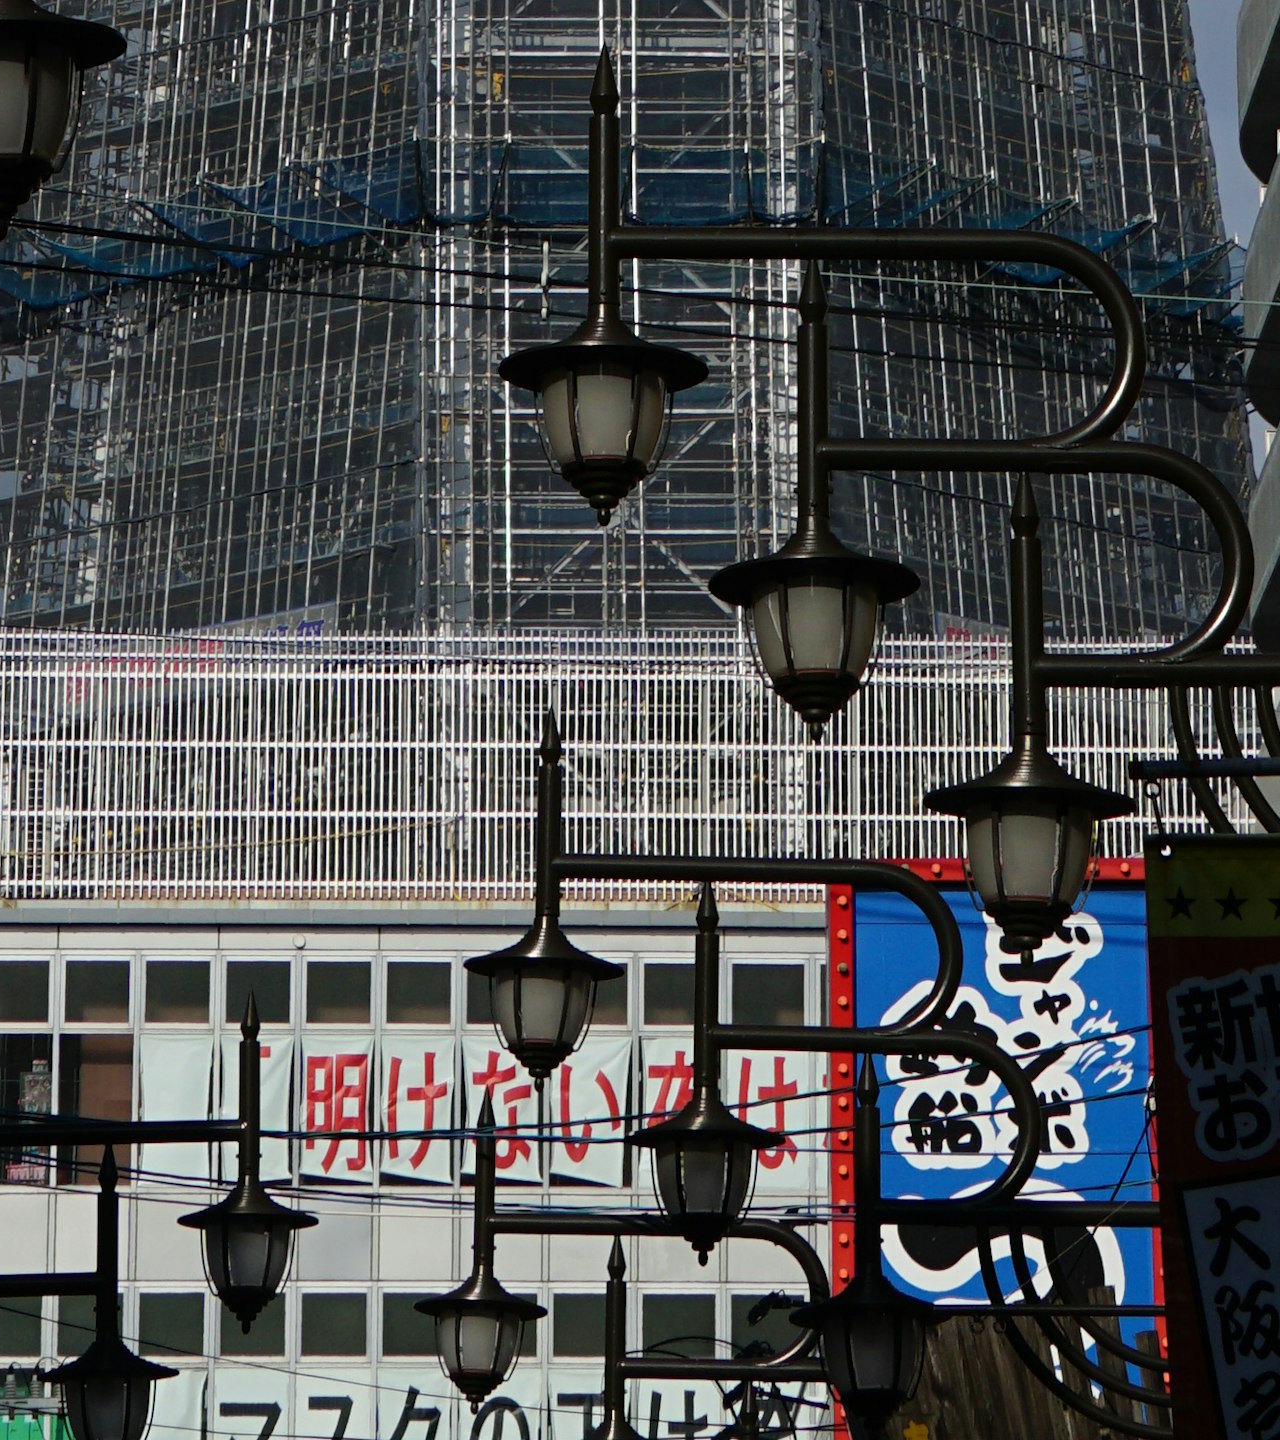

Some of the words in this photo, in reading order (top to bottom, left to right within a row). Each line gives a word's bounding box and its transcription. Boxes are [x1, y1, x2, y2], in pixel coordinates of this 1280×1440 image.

[259, 1046, 827, 1178] 明けないは
